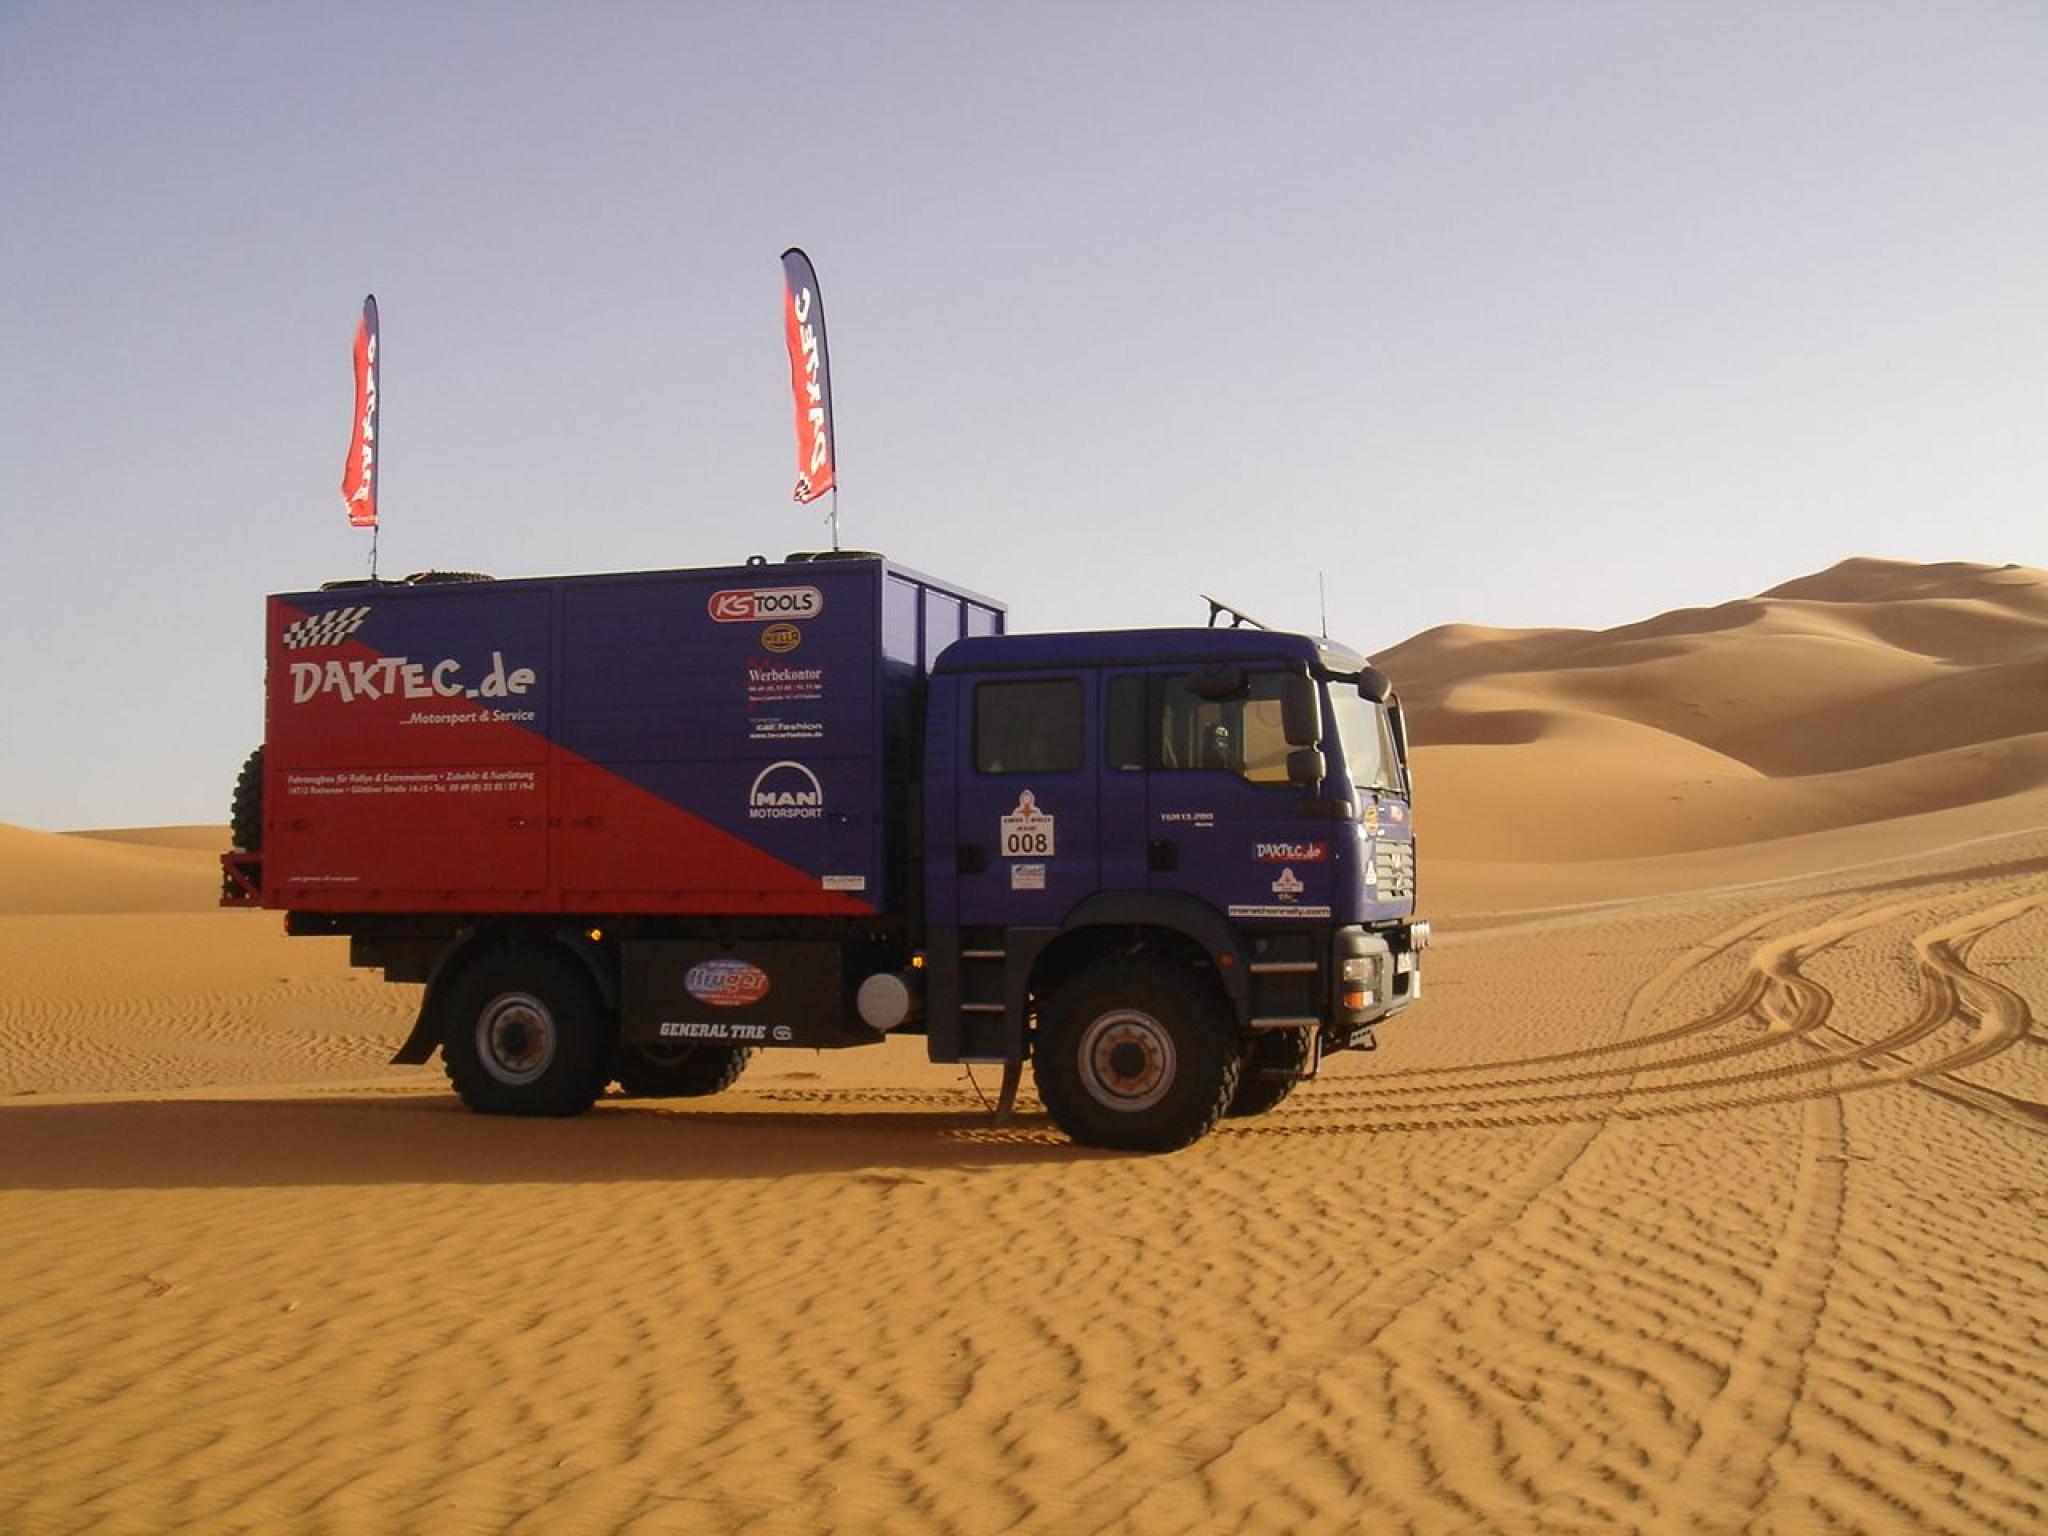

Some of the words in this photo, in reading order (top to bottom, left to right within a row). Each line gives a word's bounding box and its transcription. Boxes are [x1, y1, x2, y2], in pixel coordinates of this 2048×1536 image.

[716, 595, 753, 616] KS
[754, 593, 812, 612] TOOLS
[290, 651, 536, 703] DAKTEC.de
[748, 668, 822, 682] Werbekontor
[479, 711, 489, 722] &
[491, 710, 535, 722] Service
[756, 792, 817, 806] MAN
[749, 807, 823, 819] MOTORSPORT
[1008, 833, 1048, 853] 008
[660, 1021, 729, 1038] GENERAL
[730, 1024, 766, 1039] TIRE
